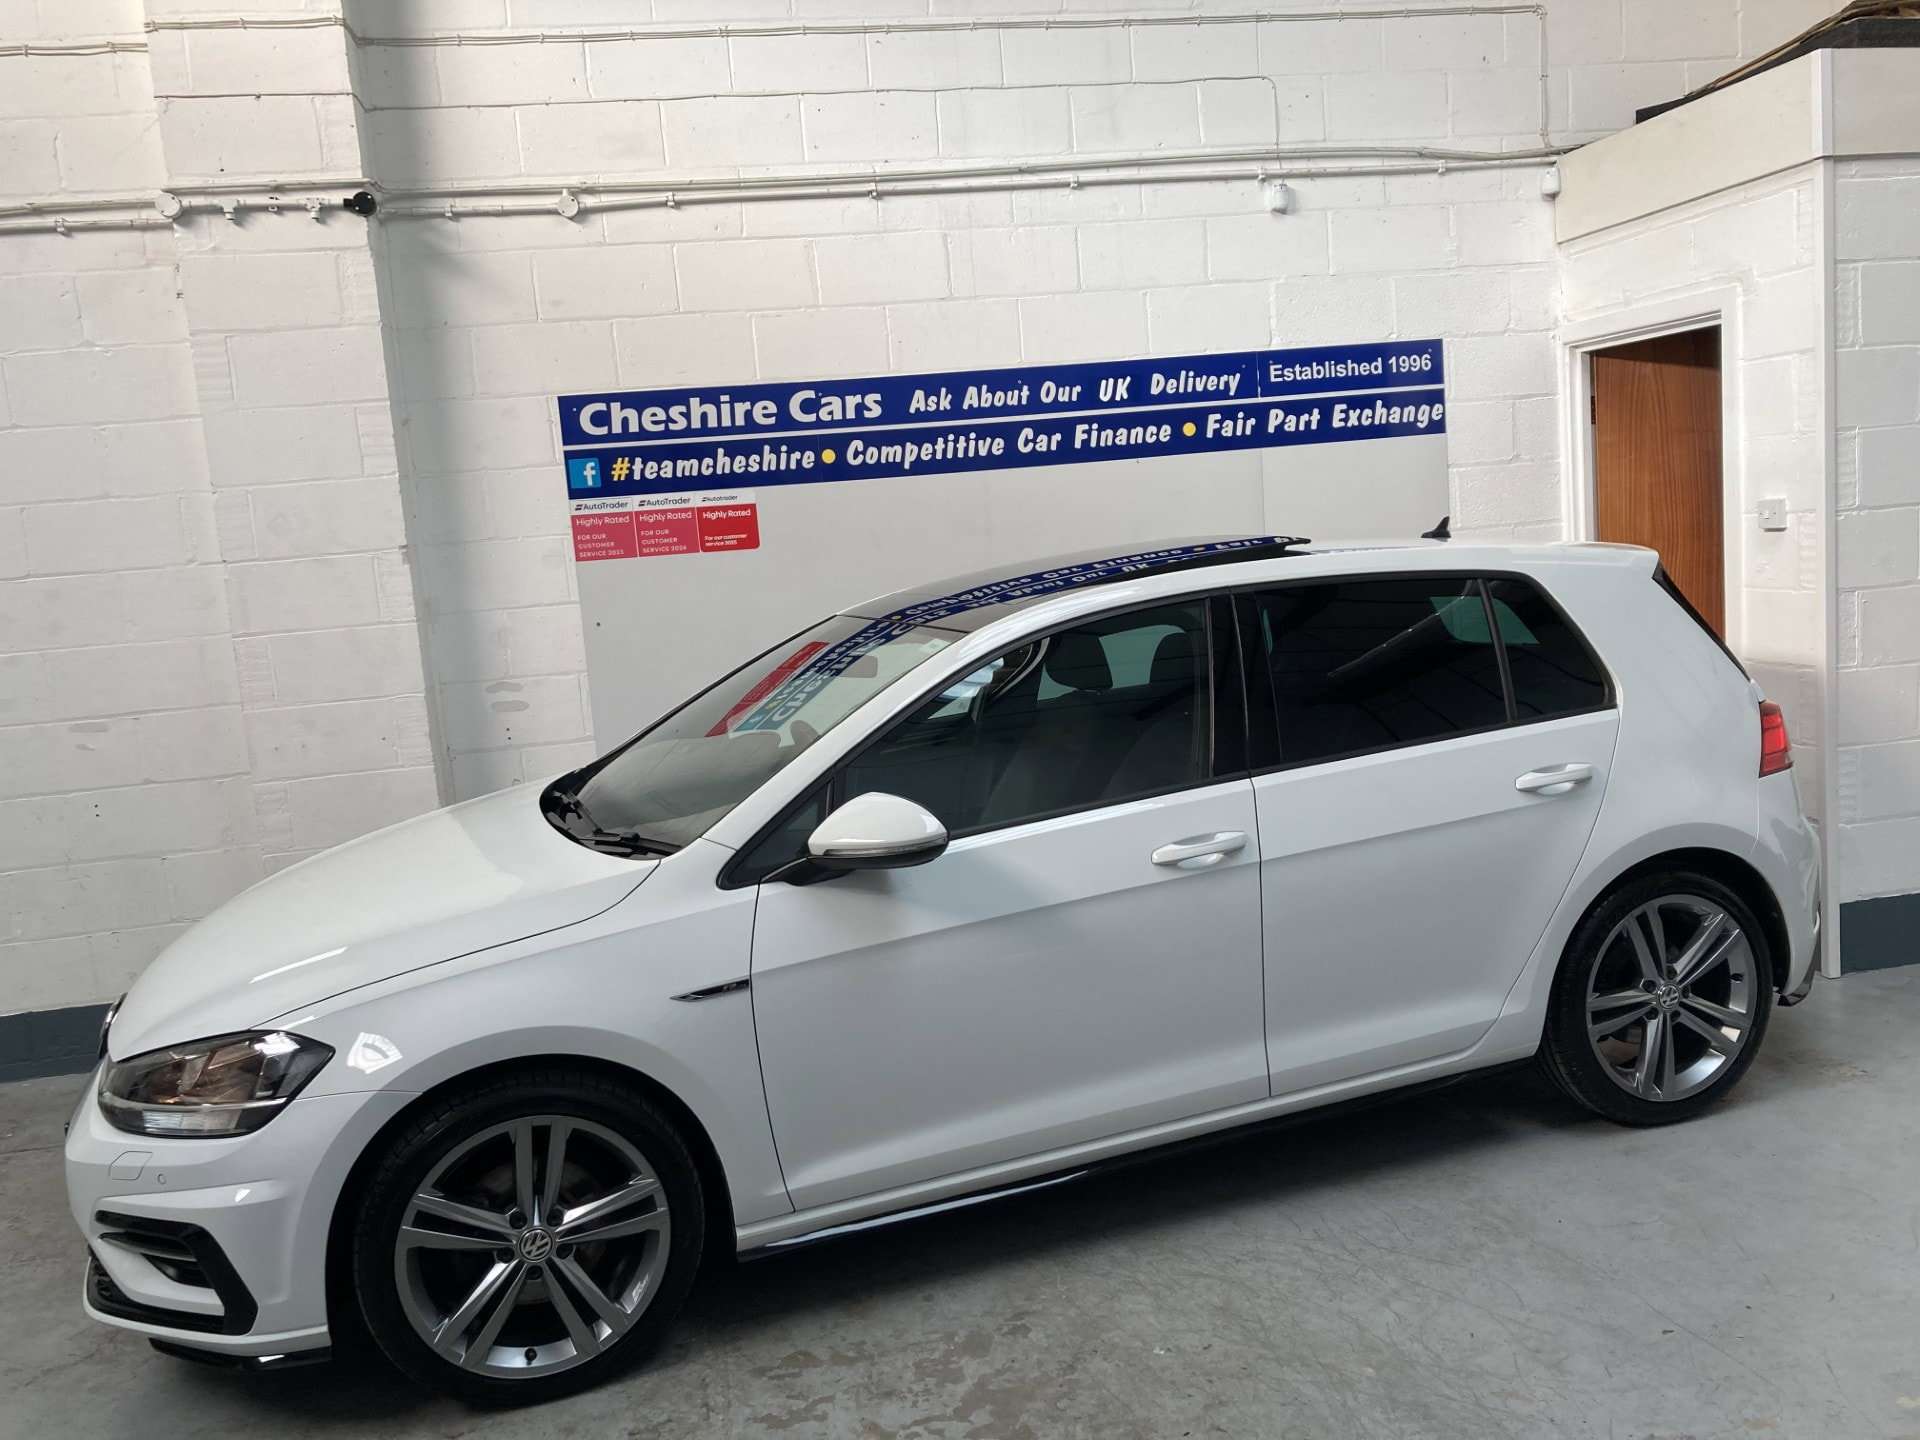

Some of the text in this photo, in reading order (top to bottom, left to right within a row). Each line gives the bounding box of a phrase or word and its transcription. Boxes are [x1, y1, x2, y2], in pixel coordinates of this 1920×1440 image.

[1269, 353, 1432, 382] Established 1996
[909, 370, 1241, 414] Ask About Our UK Delivery
[579, 389, 882, 436] Cheshire Cars
[1206, 400, 1444, 438] Fair Part Exchange
[846, 422, 1172, 470] Competitive Car Finance
[611, 444, 816, 481] #teamcheshire
[583, 501, 628, 511] AutoTrader
[645, 497, 691, 507] AutoTrader
[639, 510, 692, 523] Highly Rated
[703, 509, 751, 520] Highly Rated
[576, 515, 630, 528] Highly Rated
[578, 541, 615, 549] CUSTOMER
[641, 537, 678, 545] CUSTOMER
[579, 550, 607, 558] SERVICE
[642, 545, 670, 553] SERVICE
